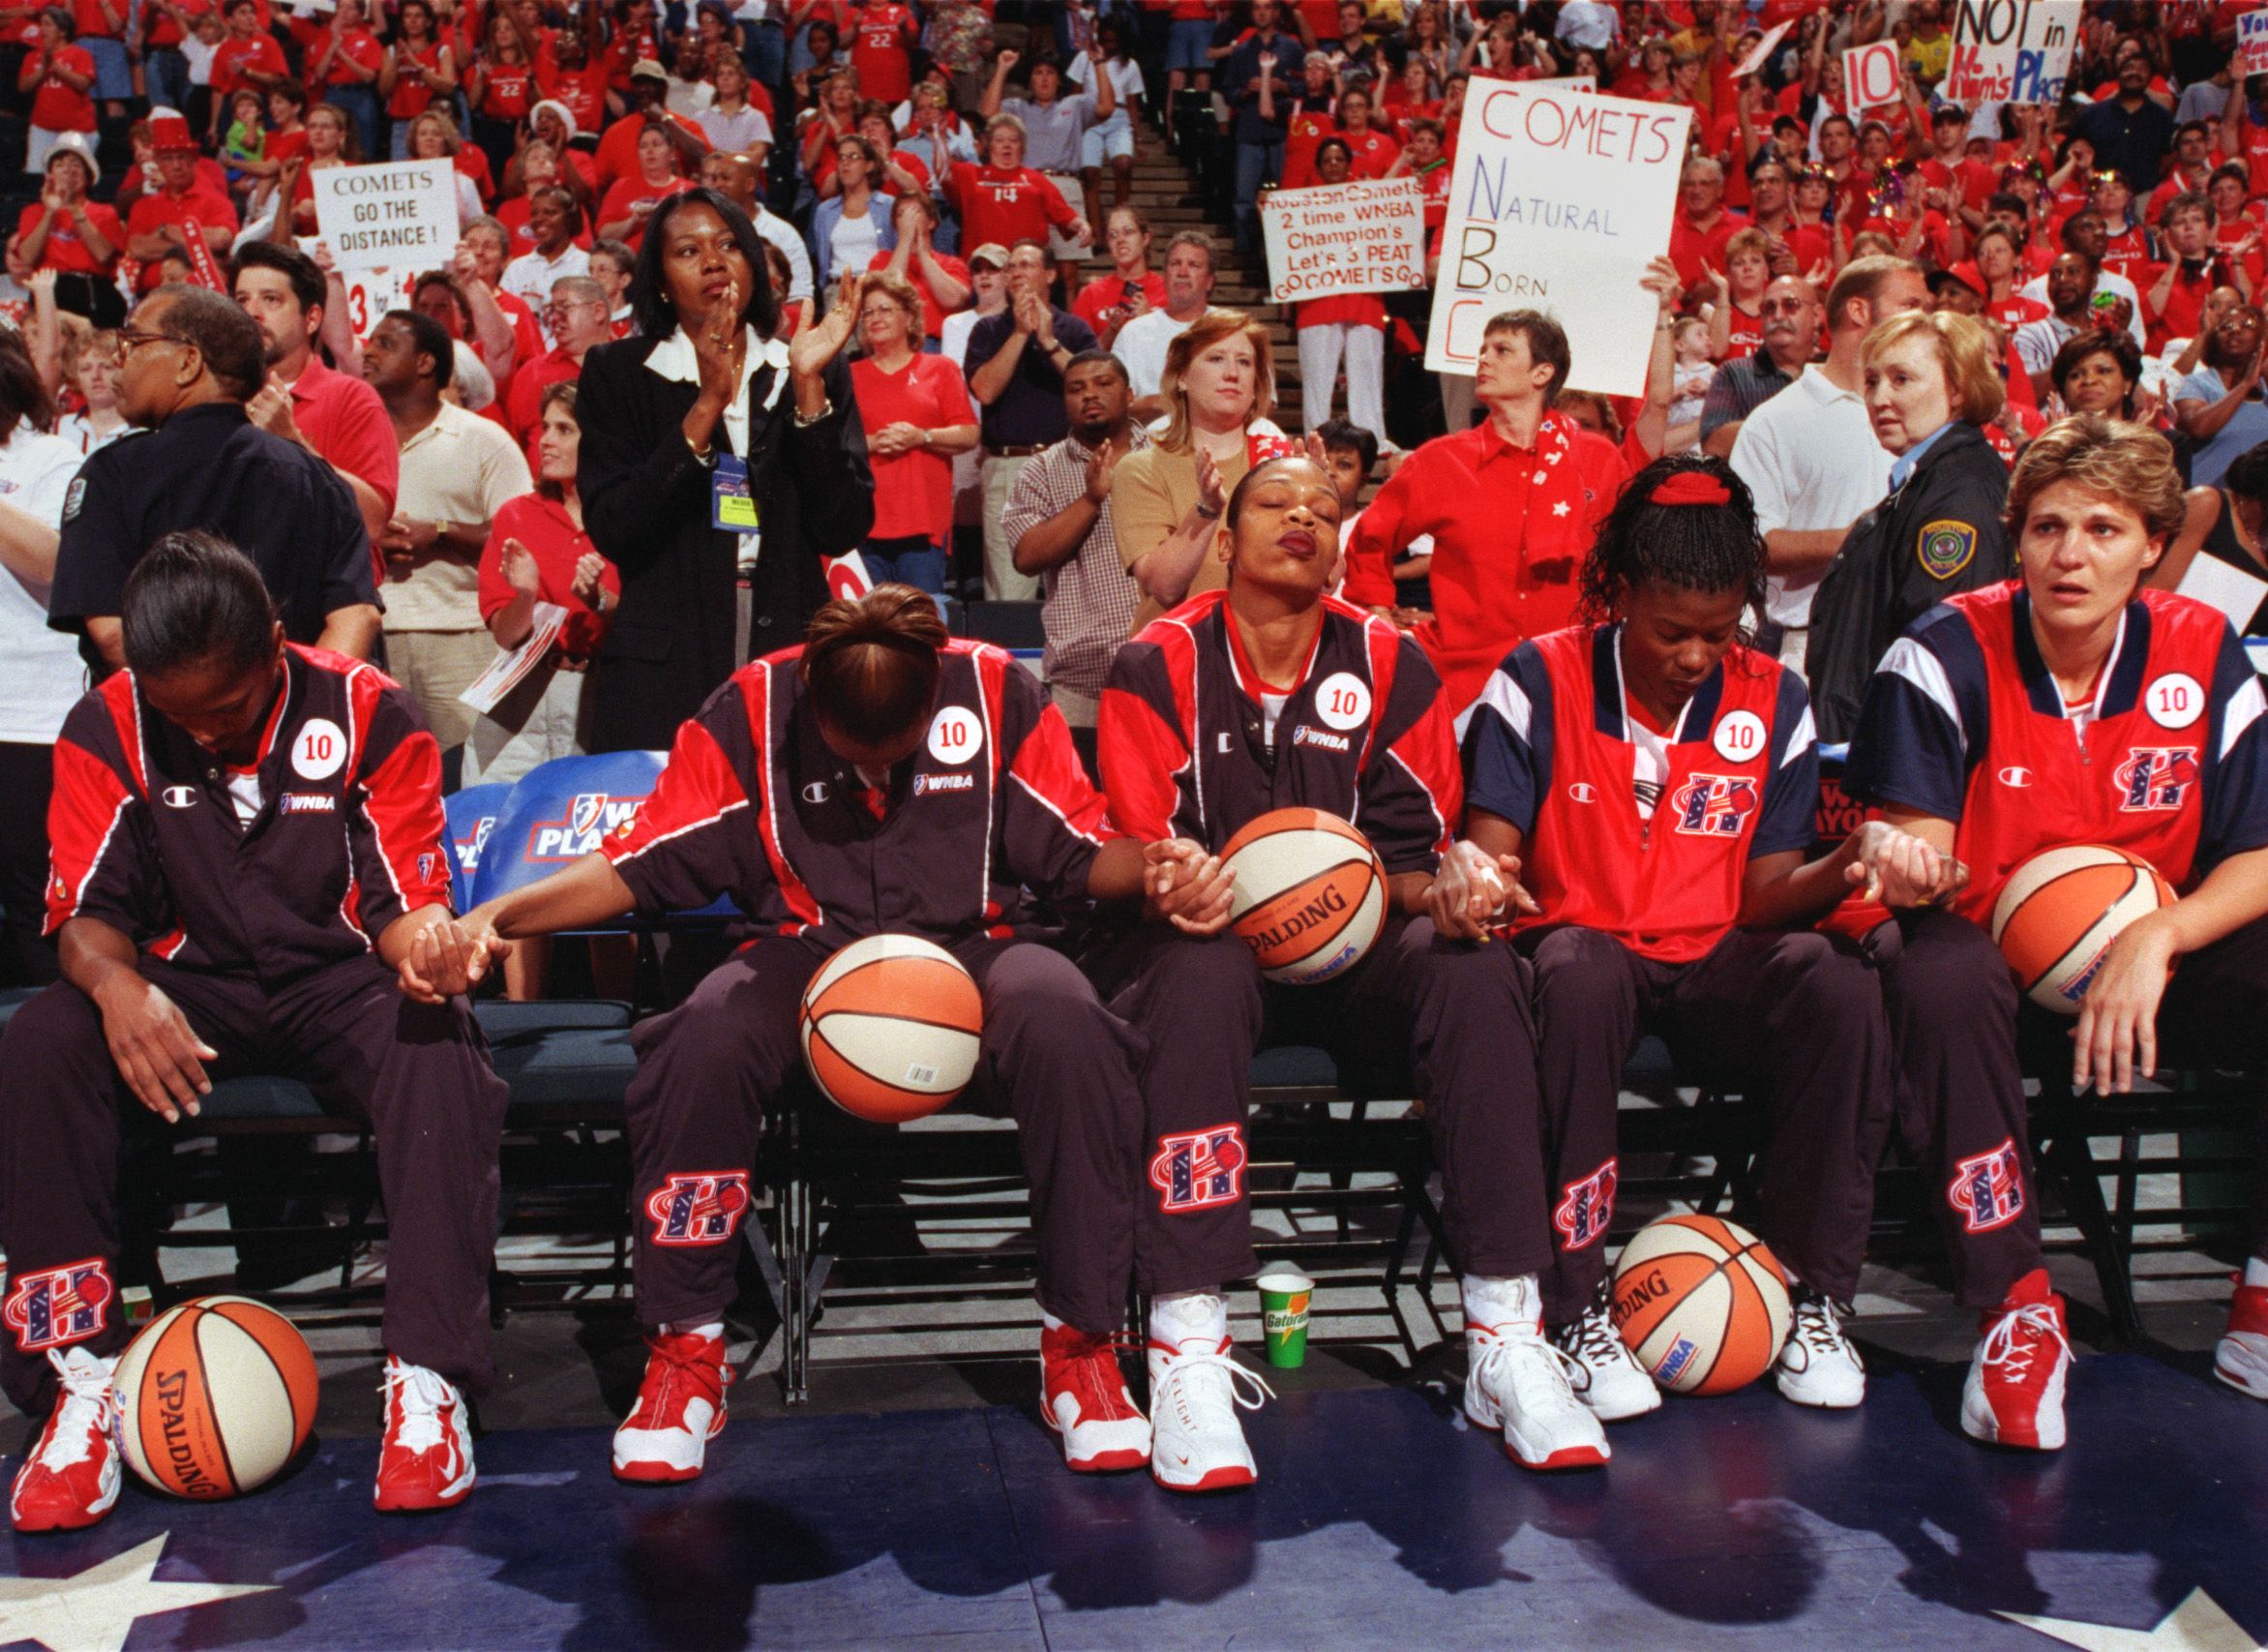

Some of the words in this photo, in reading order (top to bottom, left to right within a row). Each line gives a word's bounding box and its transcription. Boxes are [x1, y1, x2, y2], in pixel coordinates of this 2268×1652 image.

[2044, 16, 2065, 46] in
[1847, 45, 1899, 108] 10
[1481, 89, 1677, 165] COMETS
[333, 170, 433, 195] COMETS
[354, 202, 378, 224] GO
[383, 199, 418, 220] THE
[1281, 212, 1293, 229] 2
[1302, 211, 1346, 226] time
[1355, 201, 1416, 221] WNBA
[340, 225, 427, 252] DISTANCE
[1367, 244, 1413, 262] PEAT
[349, 284, 369, 335] 3
[1330, 688, 1358, 715] 10
[2159, 687, 2189, 712] 10
[940, 721, 967, 747] 10
[1307, 730, 1350, 751] WNBA
[1728, 724, 1754, 749] 10
[305, 735, 333, 761] 10
[928, 774, 973, 791] WNBA
[290, 796, 335, 810] WNBA
[1240, 882, 1348, 956] PALDING
[1656, 1338, 1695, 1382] WNBA
[1172, 1377, 1199, 1432] FLIGHT
[156, 1368, 220, 1496] SPALDING
